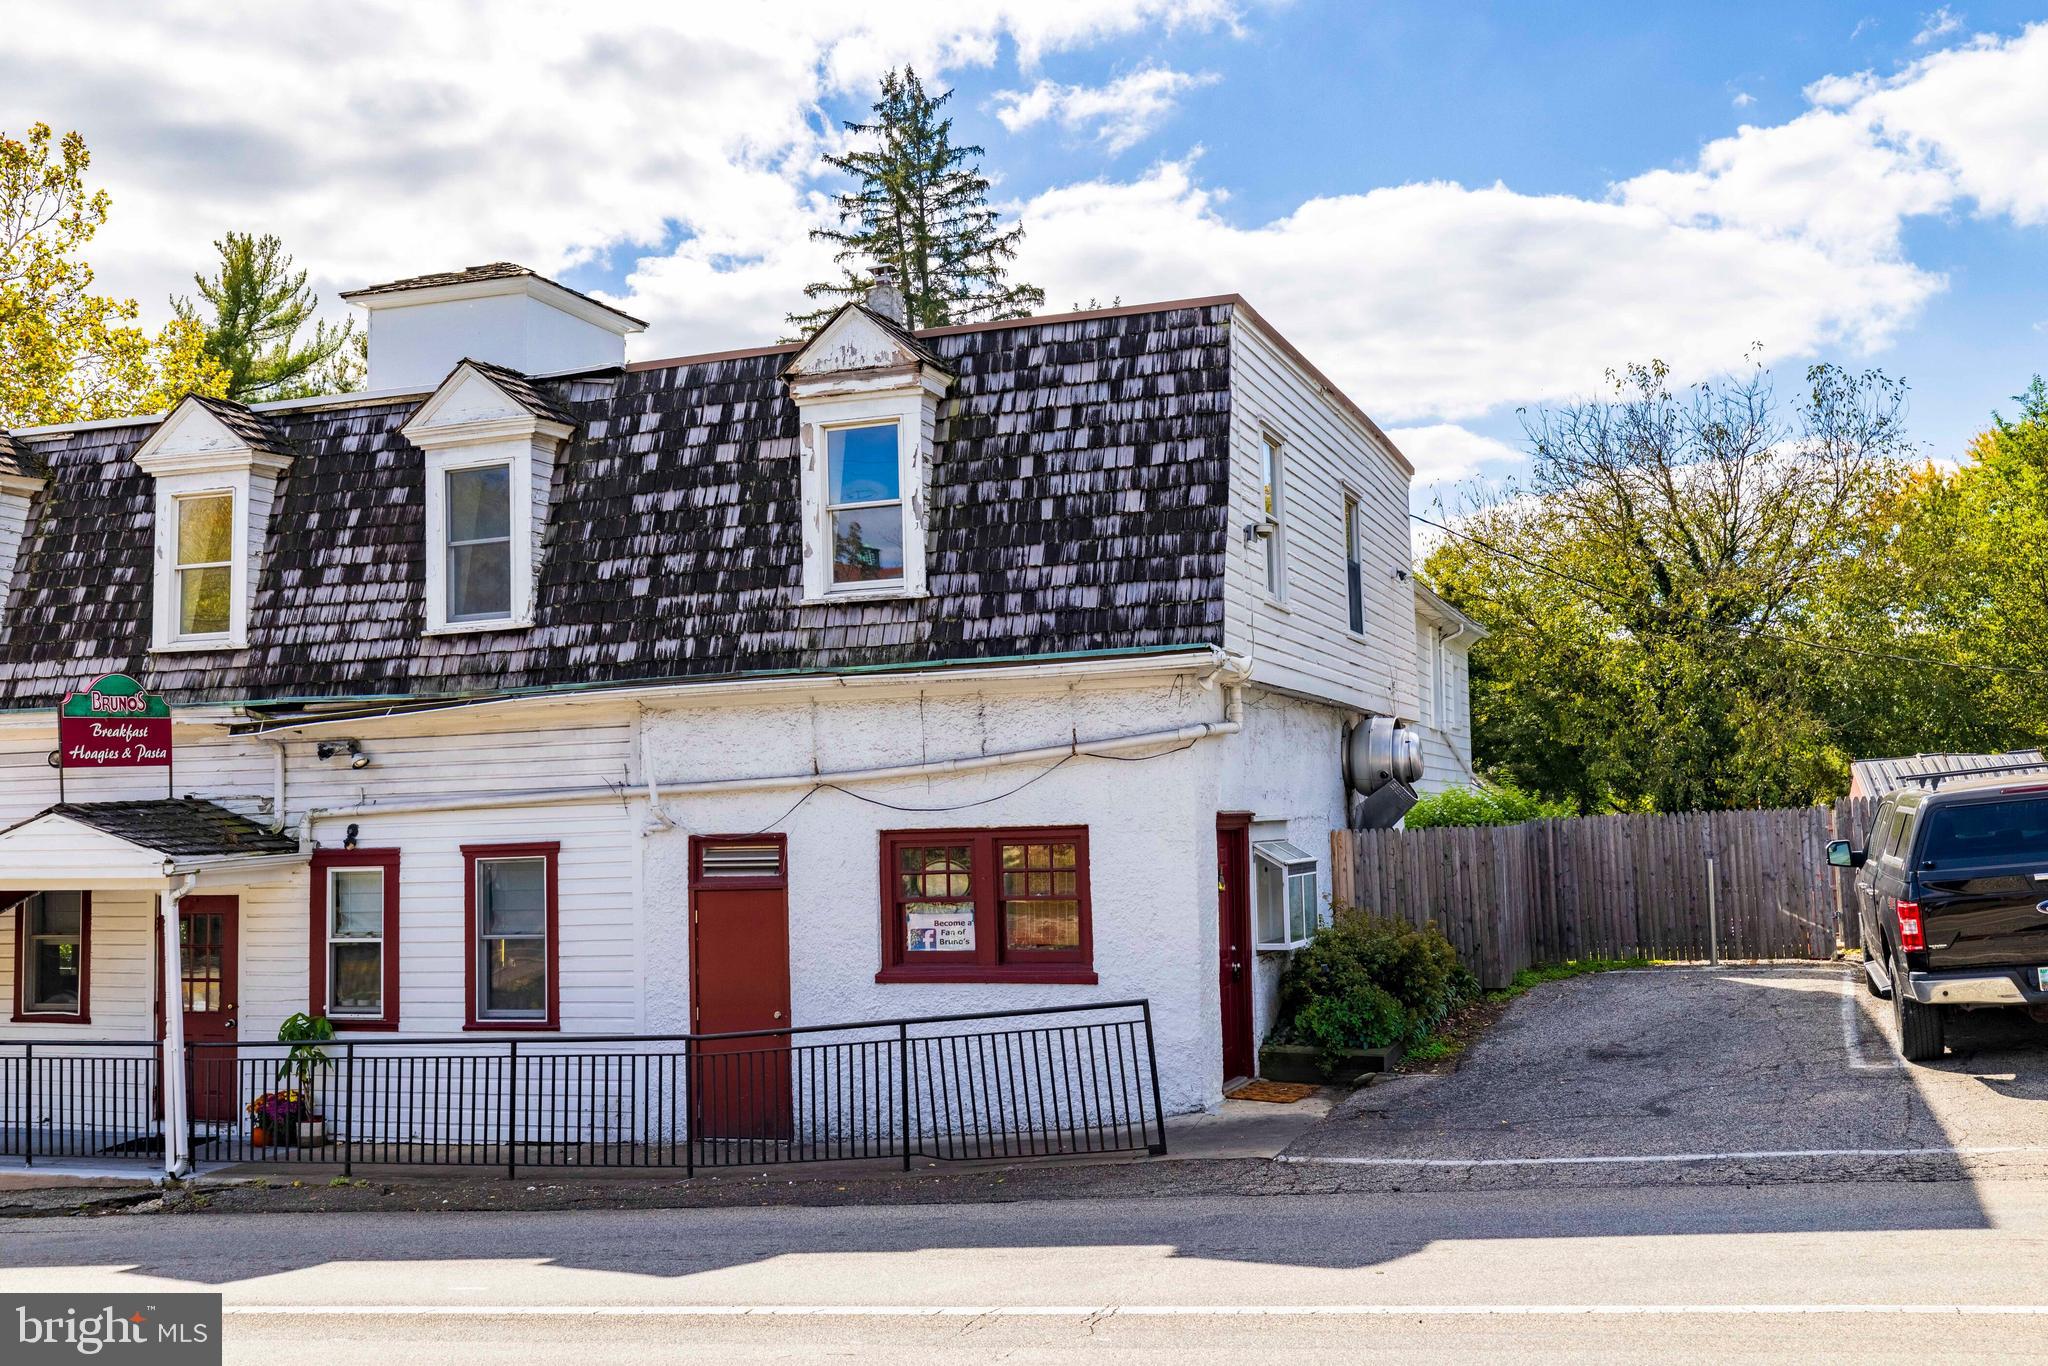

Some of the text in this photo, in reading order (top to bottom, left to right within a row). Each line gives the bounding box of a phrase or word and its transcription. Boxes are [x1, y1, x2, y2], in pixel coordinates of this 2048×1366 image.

[89, 722, 149, 742] Breakfast
[69, 744, 167, 764] Hoagies & Pasta
[957, 928, 967, 936] of
[939, 938, 970, 946] Bruno's
